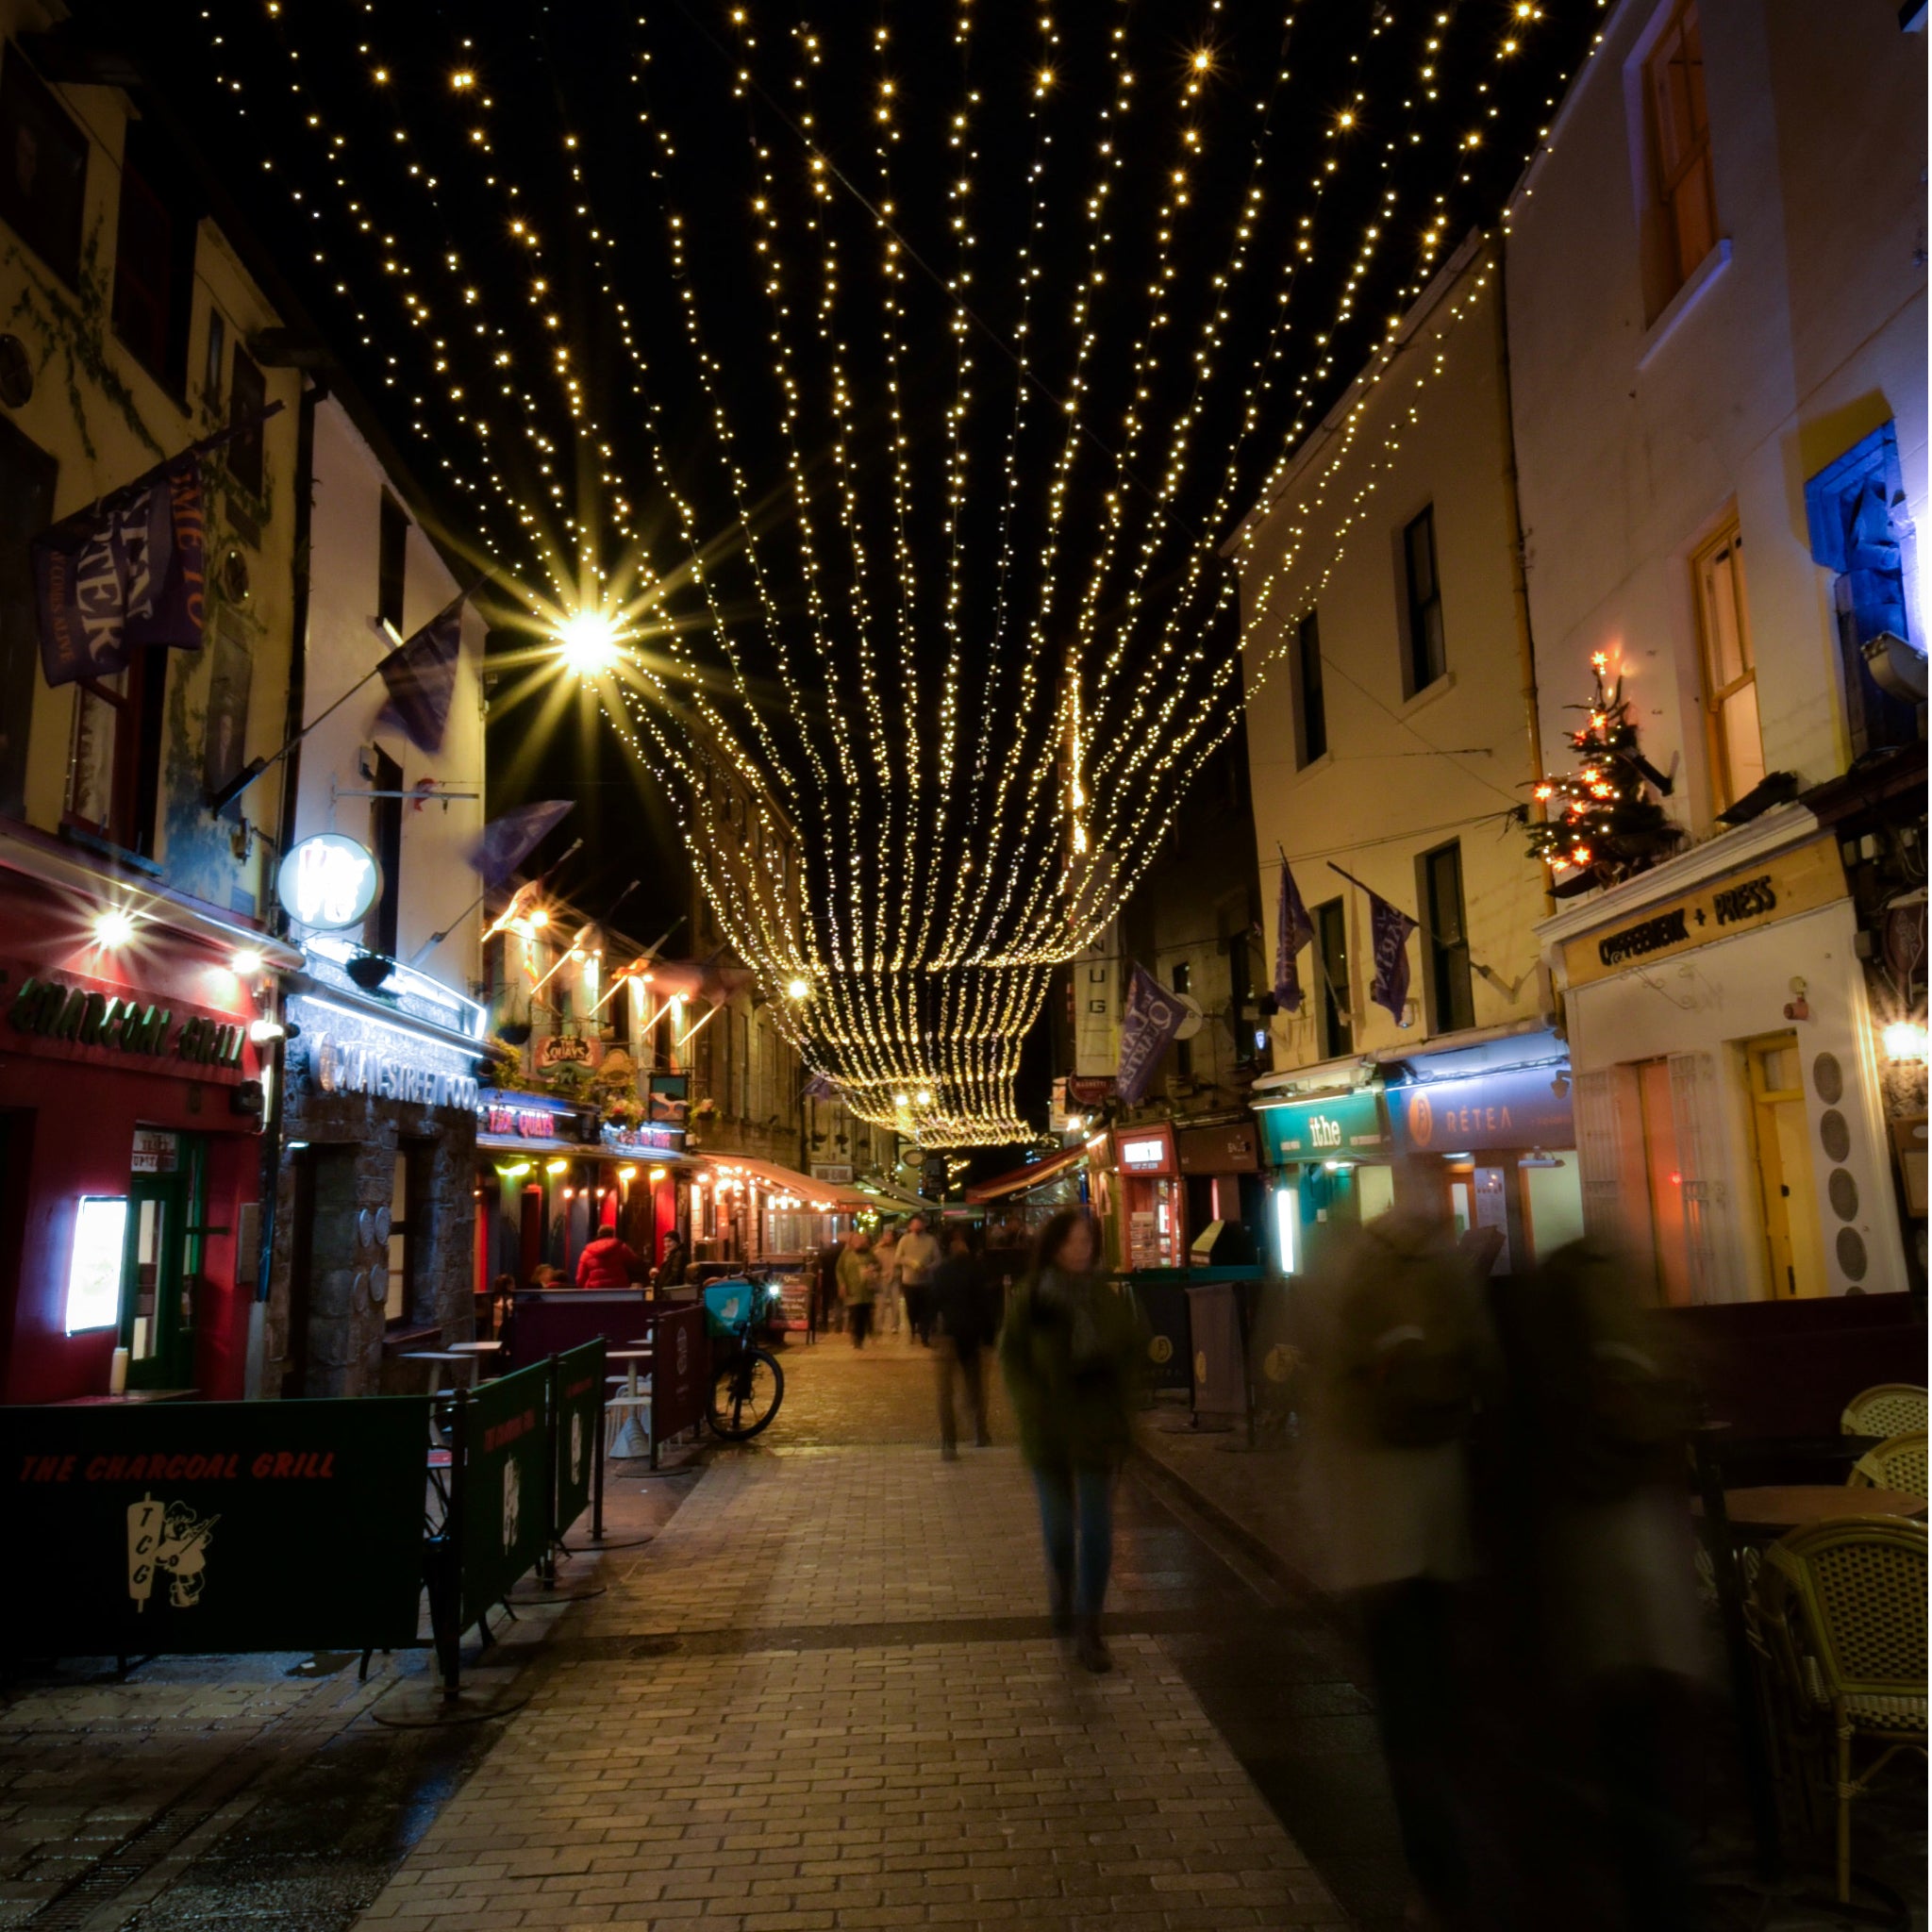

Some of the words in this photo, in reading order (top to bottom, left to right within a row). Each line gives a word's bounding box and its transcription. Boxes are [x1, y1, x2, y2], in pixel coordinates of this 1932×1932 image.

[1713, 874, 1776, 925] PRESS
[9, 977, 172, 1057] CHARCOAL
[178, 1015, 247, 1070] GRILL
[549, 1046, 586, 1059] QUAYS
[18, 1455, 78, 1483] THE
[84, 1453, 242, 1482] CHARCOAL
[250, 1451, 336, 1479] GRILL
